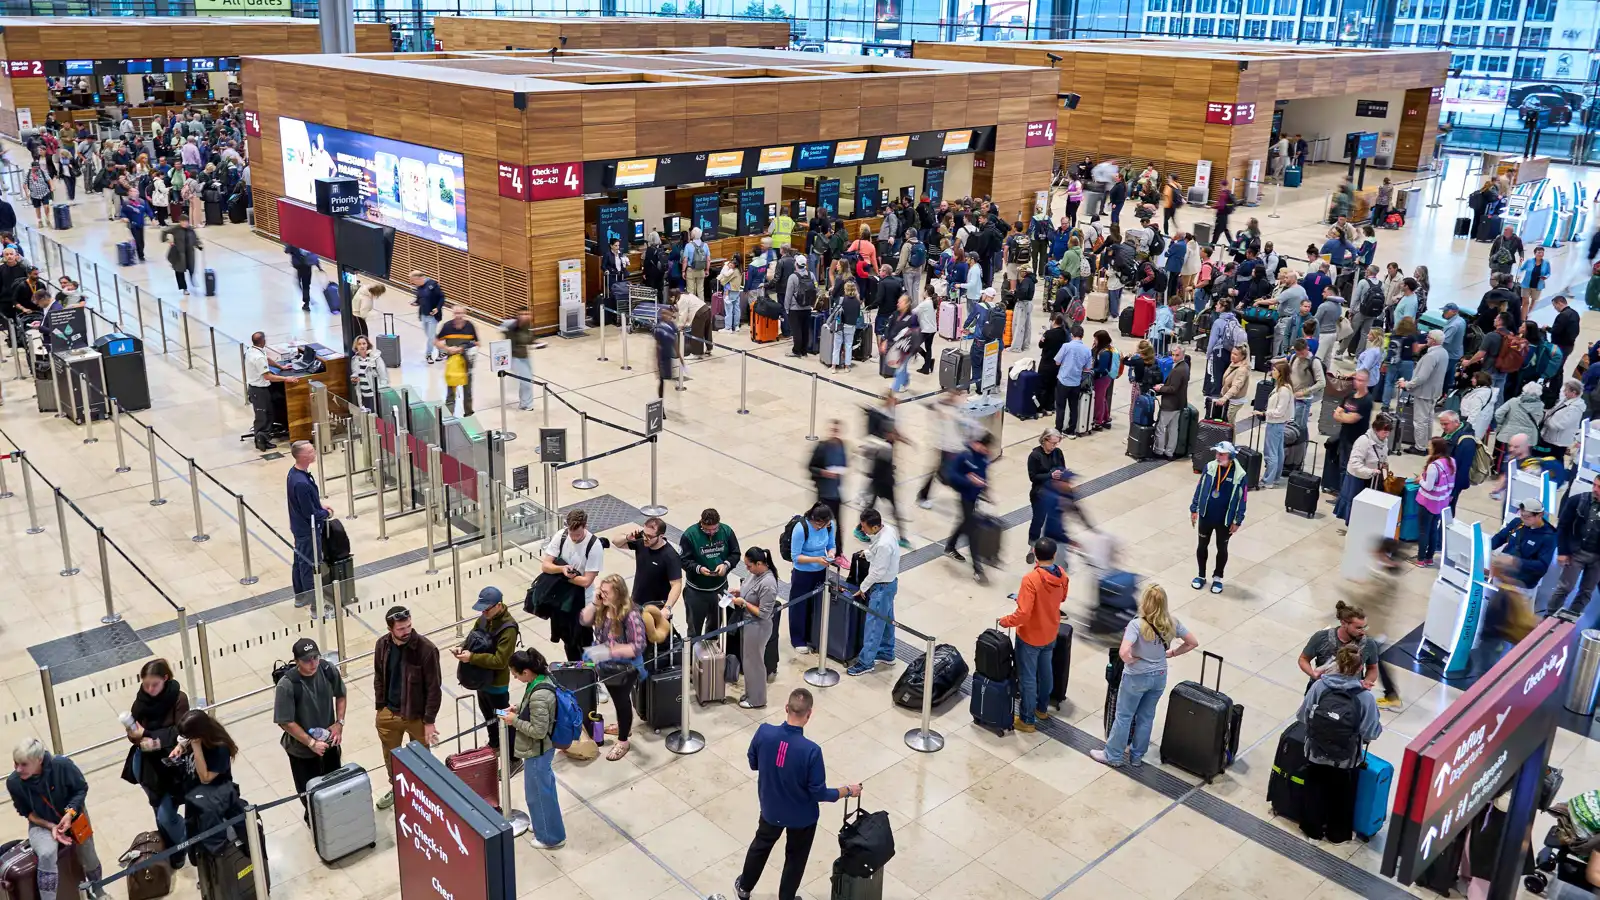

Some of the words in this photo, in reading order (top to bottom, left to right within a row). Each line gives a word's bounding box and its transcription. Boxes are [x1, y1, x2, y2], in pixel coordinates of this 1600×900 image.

[32, 60, 43, 74] 2
[253, 113, 259, 132] 4
[1222, 104, 1232, 120] 3
[1248, 104, 1255, 120] 3
[1045, 123, 1054, 140] 4
[512, 168, 523, 193] 4
[532, 166, 559, 176] Check-in
[564, 166, 579, 190] 4
[331, 195, 358, 205] Priority
[1467, 601, 1477, 623] Check
[1524, 654, 1558, 694] Check-in
[1453, 724, 1487, 766] Abflug
[411, 783, 444, 822] Ankunft
[412, 799, 432, 824] Arrival
[413, 823, 448, 864] Check-in
